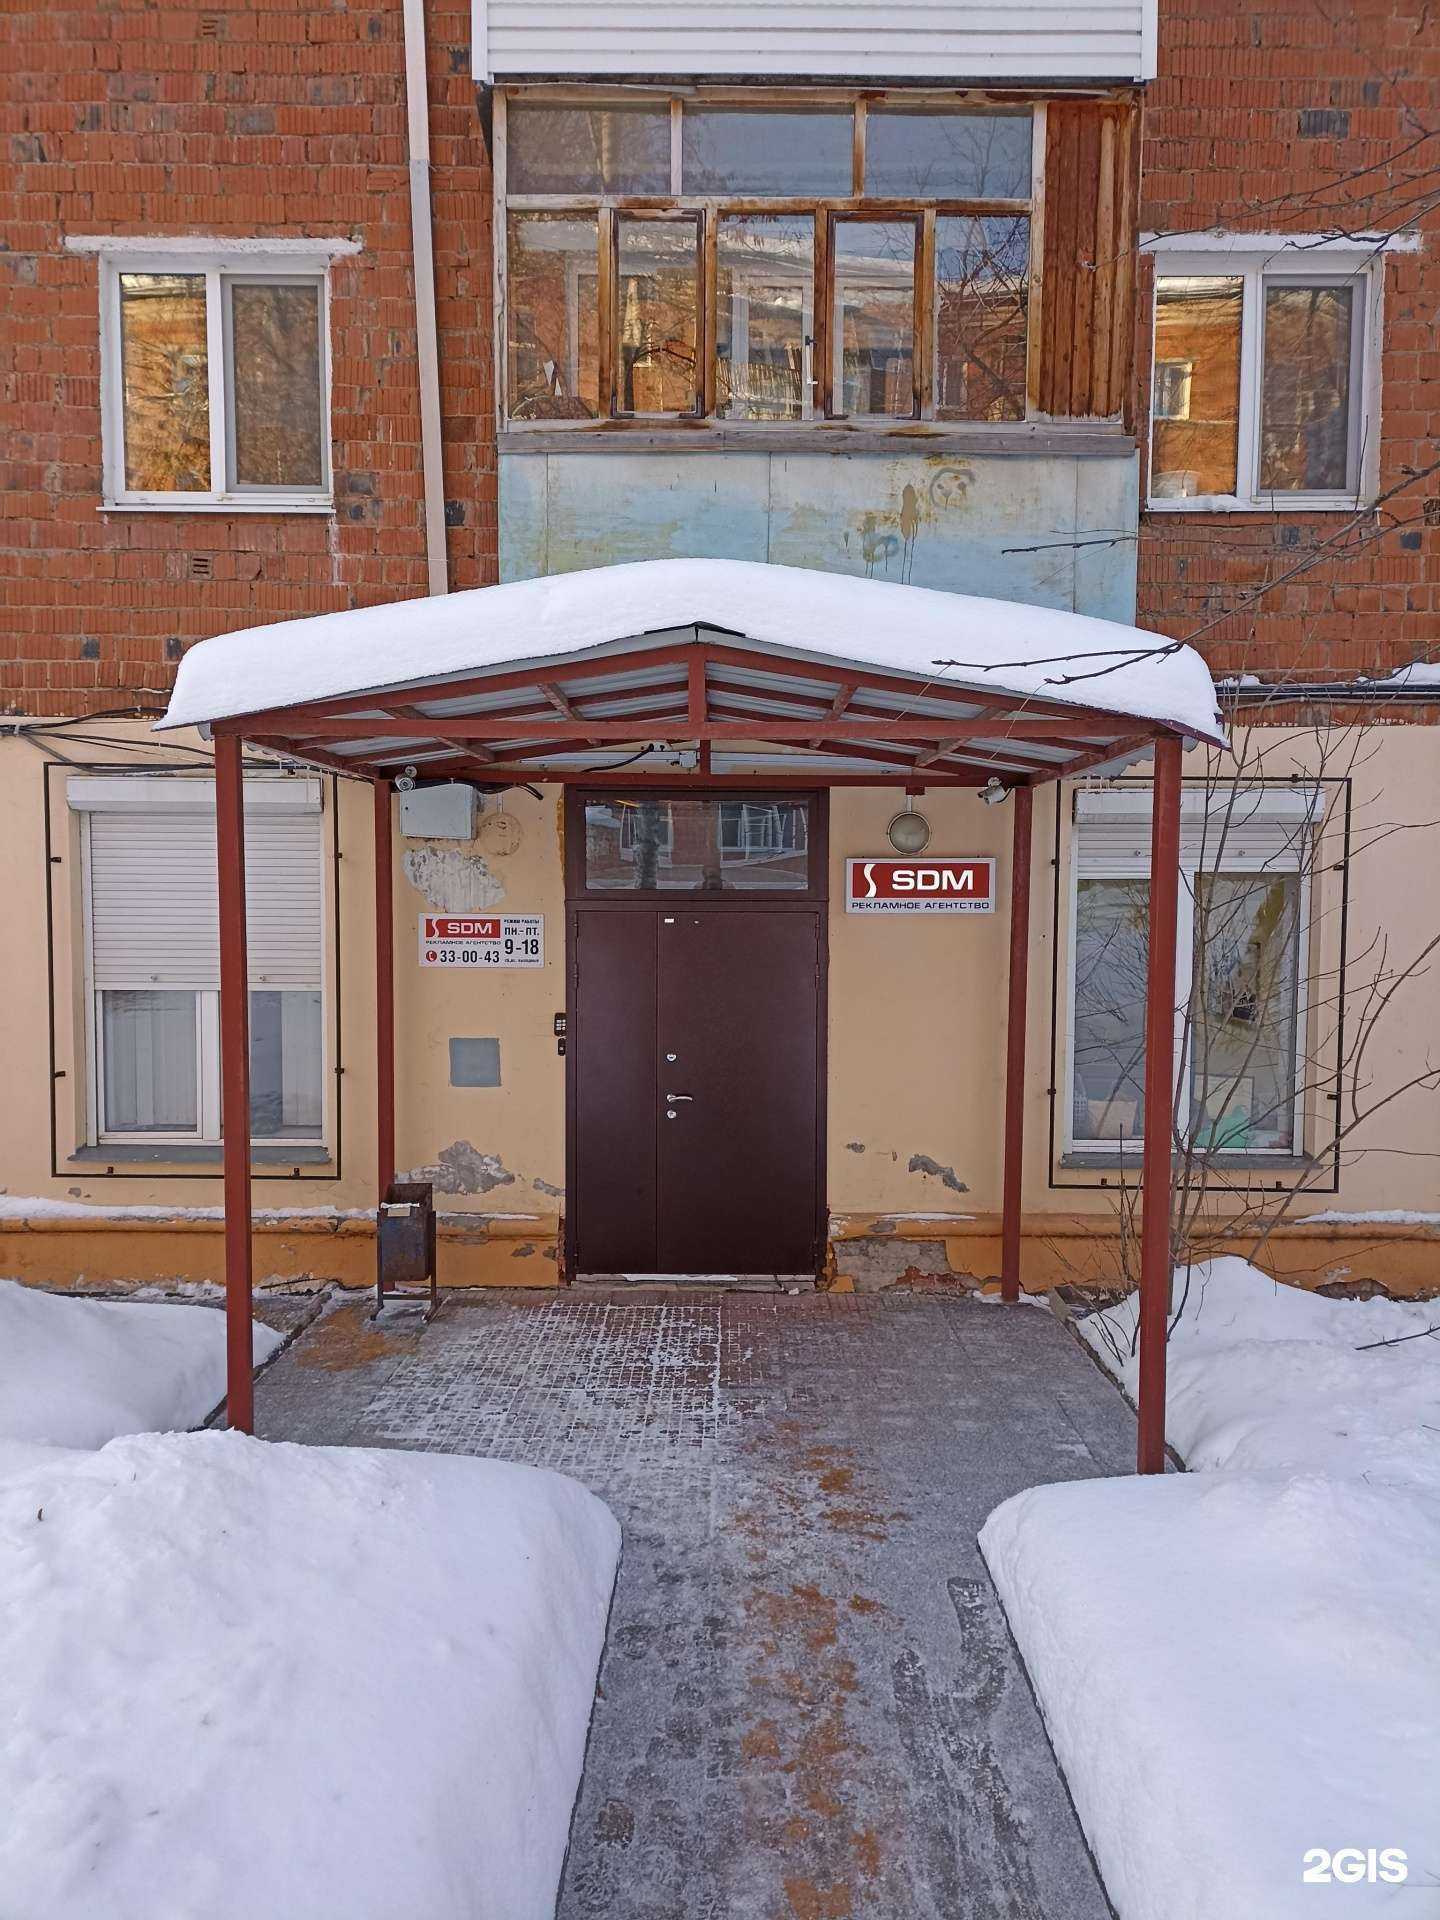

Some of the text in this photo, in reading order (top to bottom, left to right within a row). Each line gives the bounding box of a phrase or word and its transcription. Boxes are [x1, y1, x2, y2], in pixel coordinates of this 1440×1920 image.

[892, 870, 973, 890] SDM
[447, 922, 492, 934] SDM
[504, 938, 539, 955] 9-18
[440, 950, 500, 963] 33-00-43
